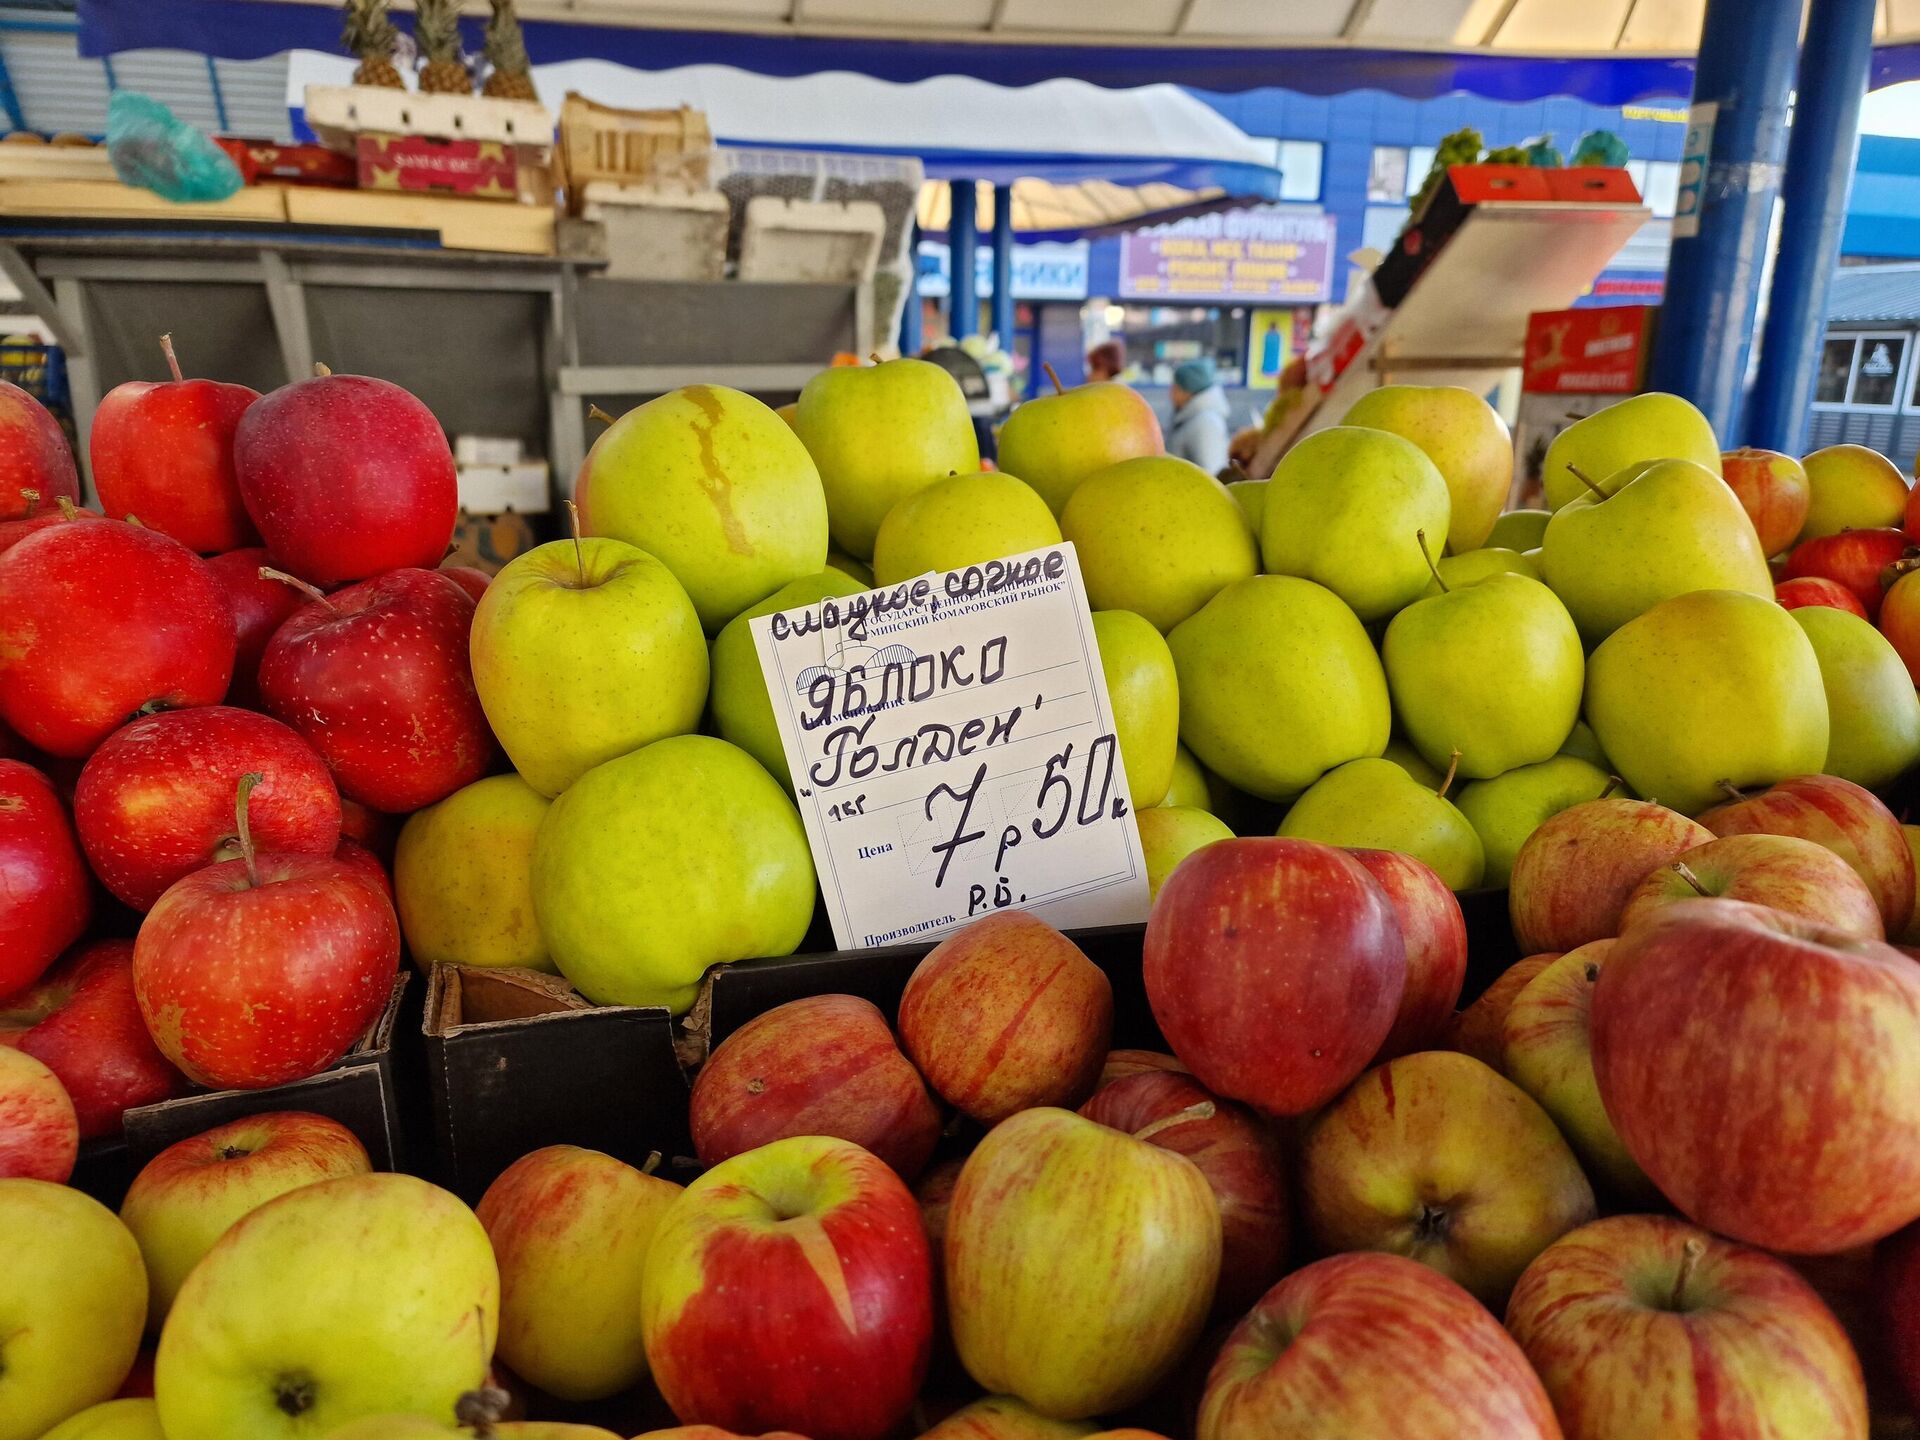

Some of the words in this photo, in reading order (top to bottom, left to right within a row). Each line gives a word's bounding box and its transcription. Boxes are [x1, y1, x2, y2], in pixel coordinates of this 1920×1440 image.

[931, 594, 1019, 623] КОМАРОВСКИЙ
[801, 635, 1008, 731] ЯБЛОКО
[857, 841, 894, 861] Цена
[924, 762, 988, 888] 7
[863, 913, 957, 948] Производитель
